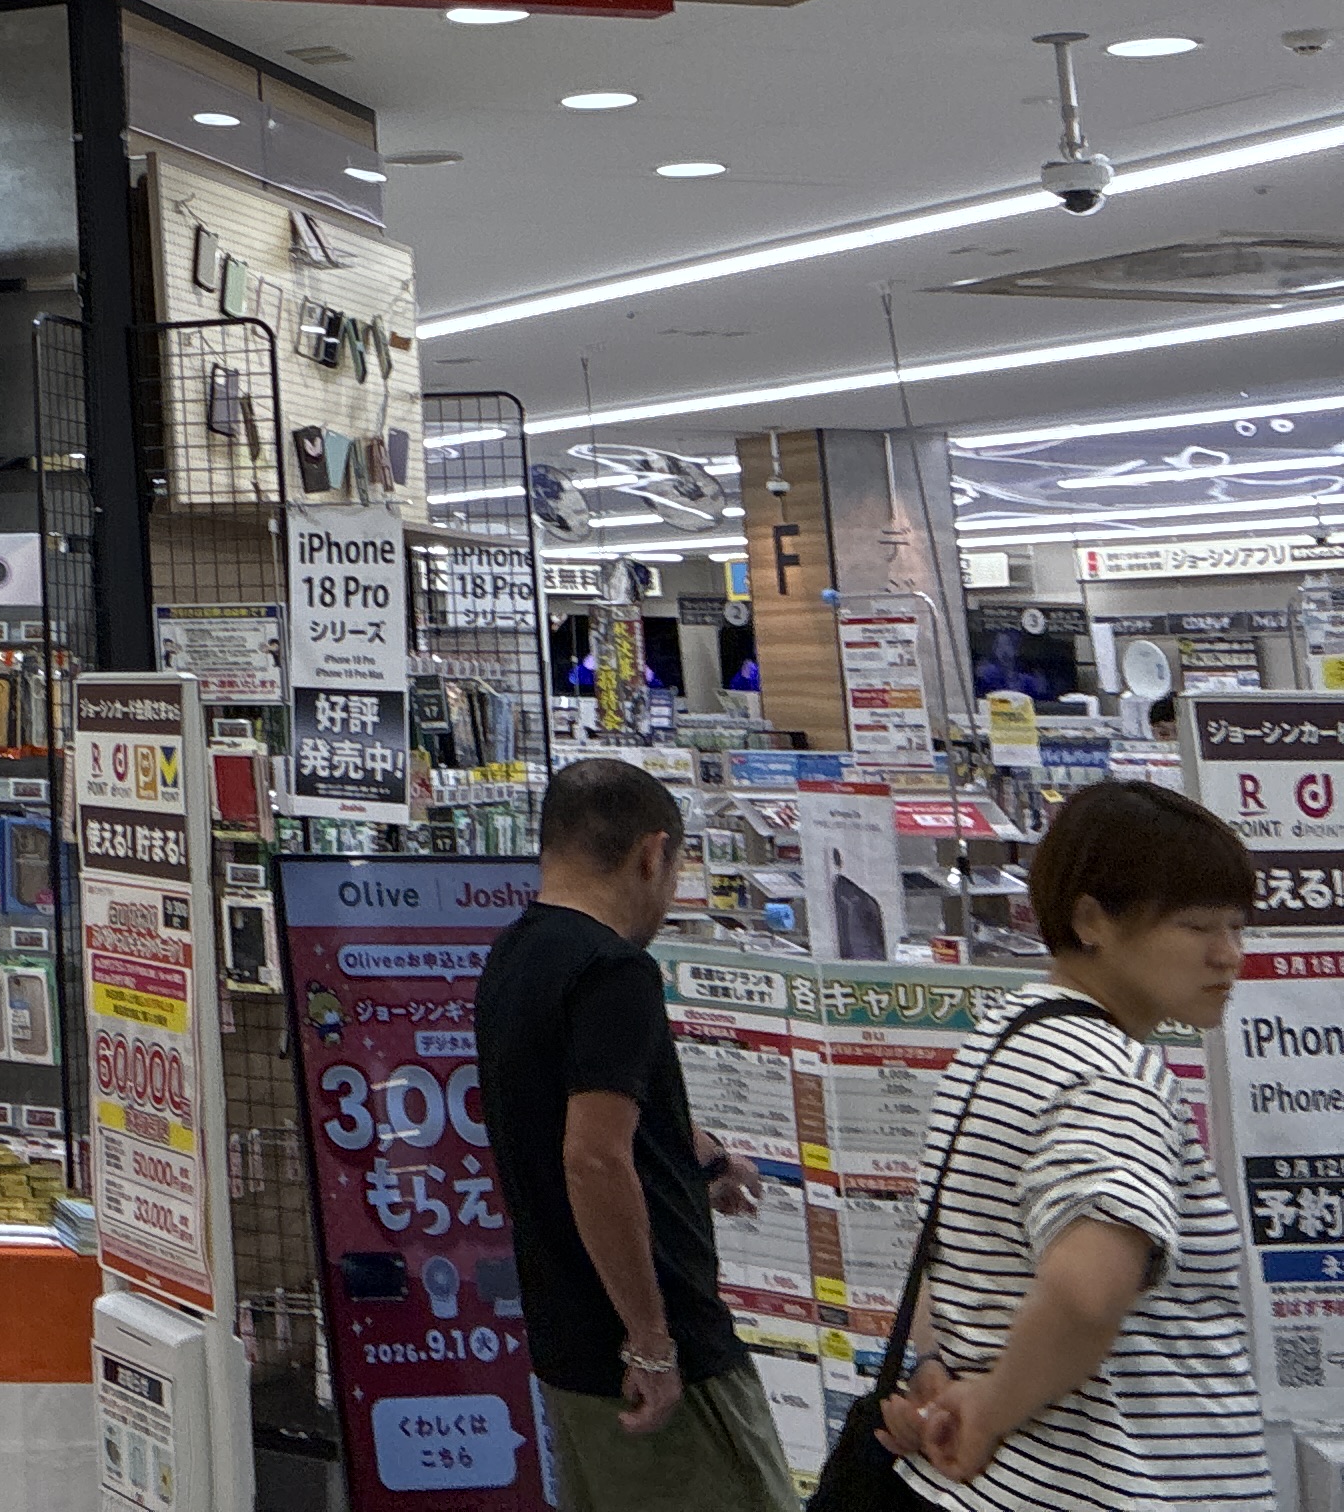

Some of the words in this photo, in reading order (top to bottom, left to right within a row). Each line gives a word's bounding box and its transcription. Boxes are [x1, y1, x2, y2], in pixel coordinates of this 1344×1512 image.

[298, 532, 395, 565] iPhone
[773, 524, 799, 595] F
[302, 576, 335, 609] 18
[345, 576, 390, 608] Pro
[459, 575, 486, 599] 18
[309, 621, 386, 645] シリーズ
[315, 693, 380, 735] 好評
[299, 738, 404, 782] 発売中!
[339, 881, 420, 908] Olive
[399, 1414, 488, 1437] くわしくは
[422, 1446, 473, 1469] こちら
